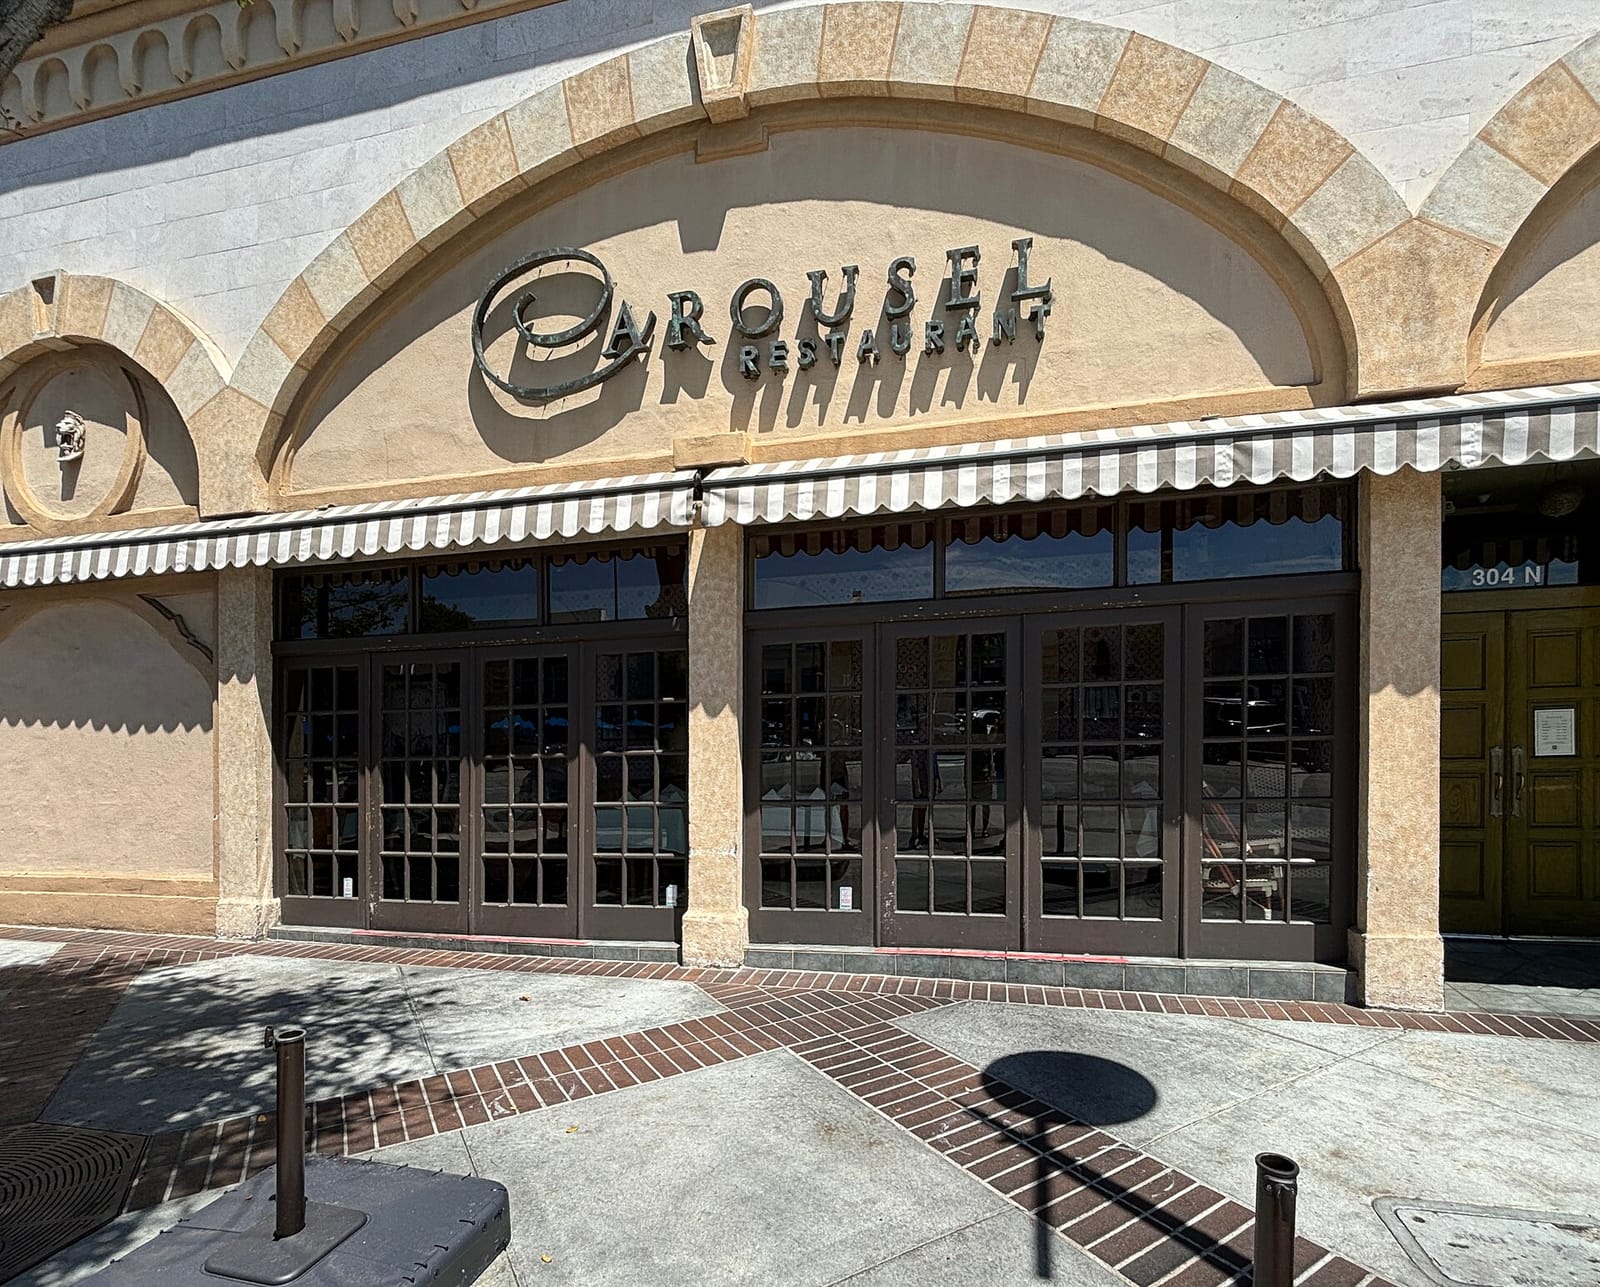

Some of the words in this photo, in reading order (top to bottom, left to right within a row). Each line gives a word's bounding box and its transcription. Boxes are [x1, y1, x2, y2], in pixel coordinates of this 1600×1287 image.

[472, 236, 1053, 402] CAROUSEL
[739, 304, 1053, 380] RESTAURANT
[1472, 567, 1515, 586] 304
[1524, 565, 1541, 584] N
